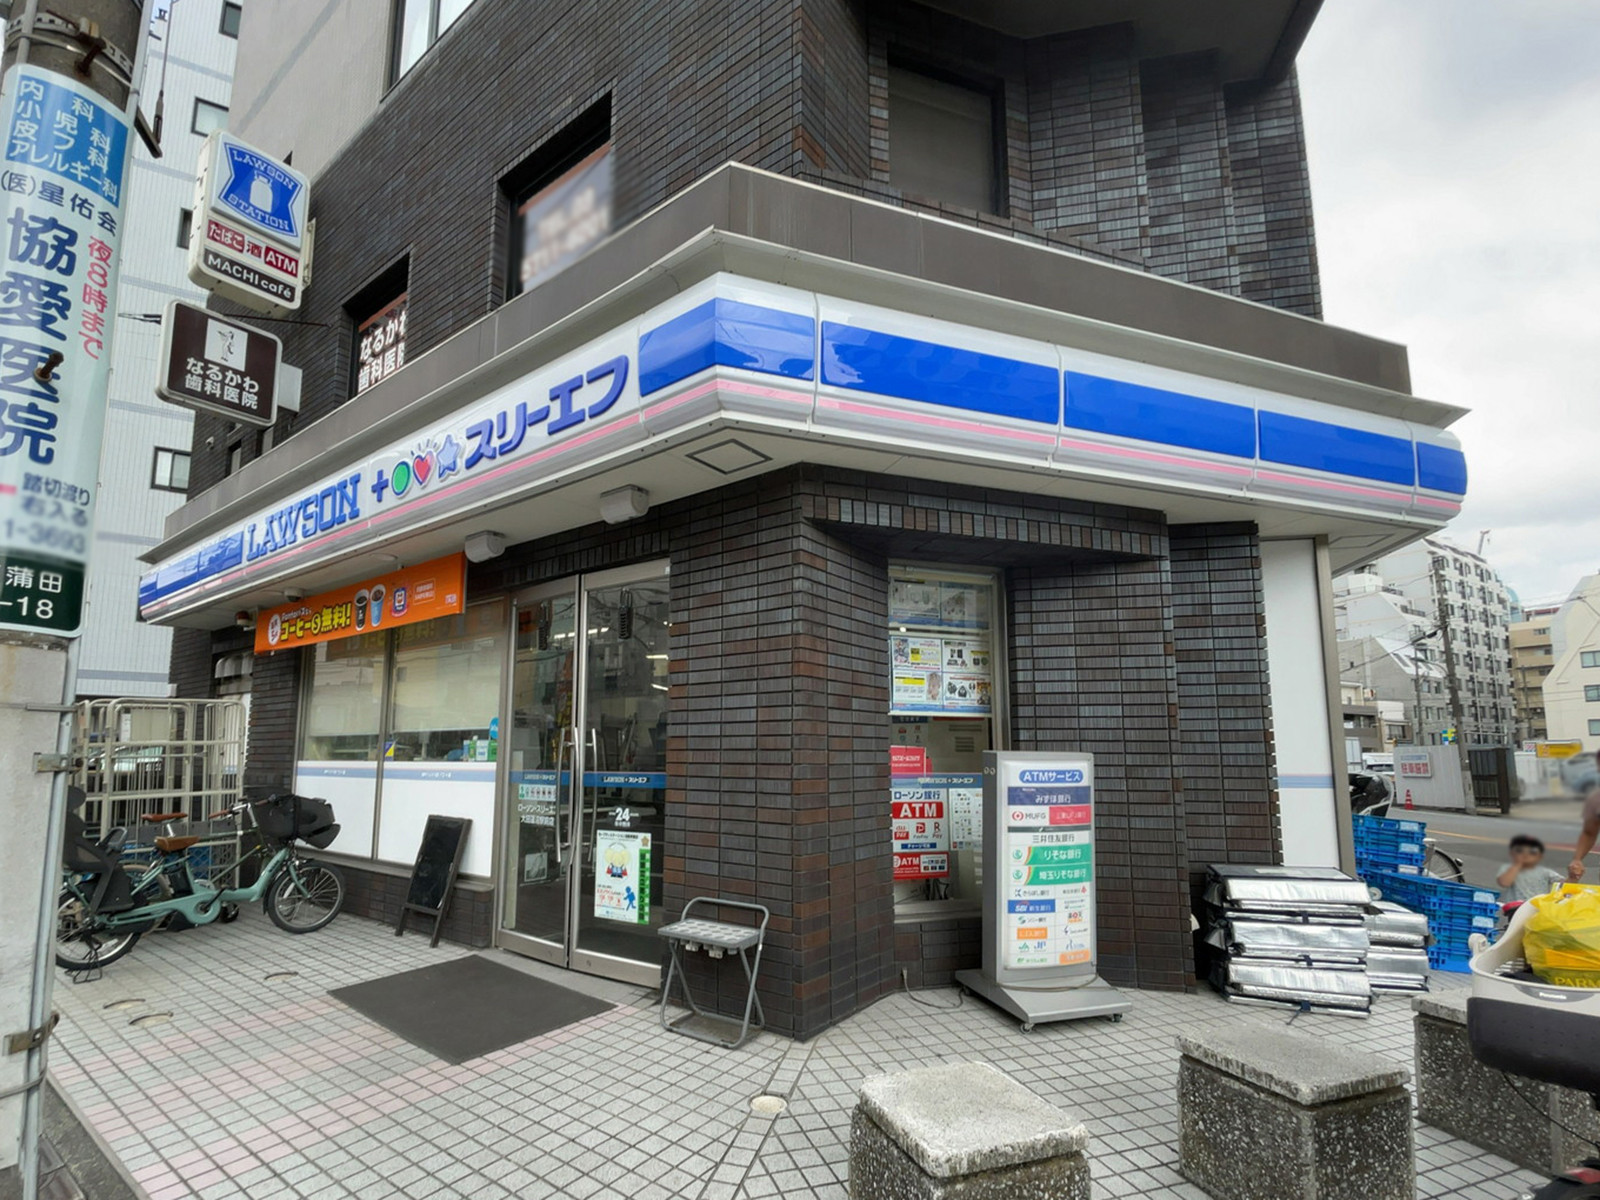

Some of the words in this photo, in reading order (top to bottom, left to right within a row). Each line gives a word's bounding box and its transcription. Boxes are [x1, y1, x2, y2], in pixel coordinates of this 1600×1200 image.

[9, 139, 118, 202] アレルギー科
[231, 150, 296, 191] LAWSON
[227, 193, 290, 232] STATION
[208, 223, 243, 252] たばこ
[266, 252, 297, 275] ATM
[208, 254, 259, 285] MACHI
[260, 279, 292, 299] café
[78, 235, 113, 360] 夜8時まで
[0, 207, 78, 465] 協愛医院
[186, 357, 259, 393] なるかわ
[184, 373, 258, 410] 歯科医院
[464, 354, 630, 471] スリーエフ
[245, 472, 361, 561] LAWSON
[5, 566, 62, 593] 蒲田
[1022, 771, 1081, 782] ATMサービス
[893, 790, 941, 800] ローソン銀行
[900, 803, 937, 818] ATM
[1034, 793, 1072, 804] みずほ銀行
[615, 807, 630, 821] 24
[1025, 812, 1047, 820] MUFG
[1032, 833, 1075, 844] 三井住友銀行
[901, 857, 920, 865] ATM
[1043, 849, 1082, 860] りそな銀行
[1039, 868, 1087, 880] 埼玉りそな銀行
